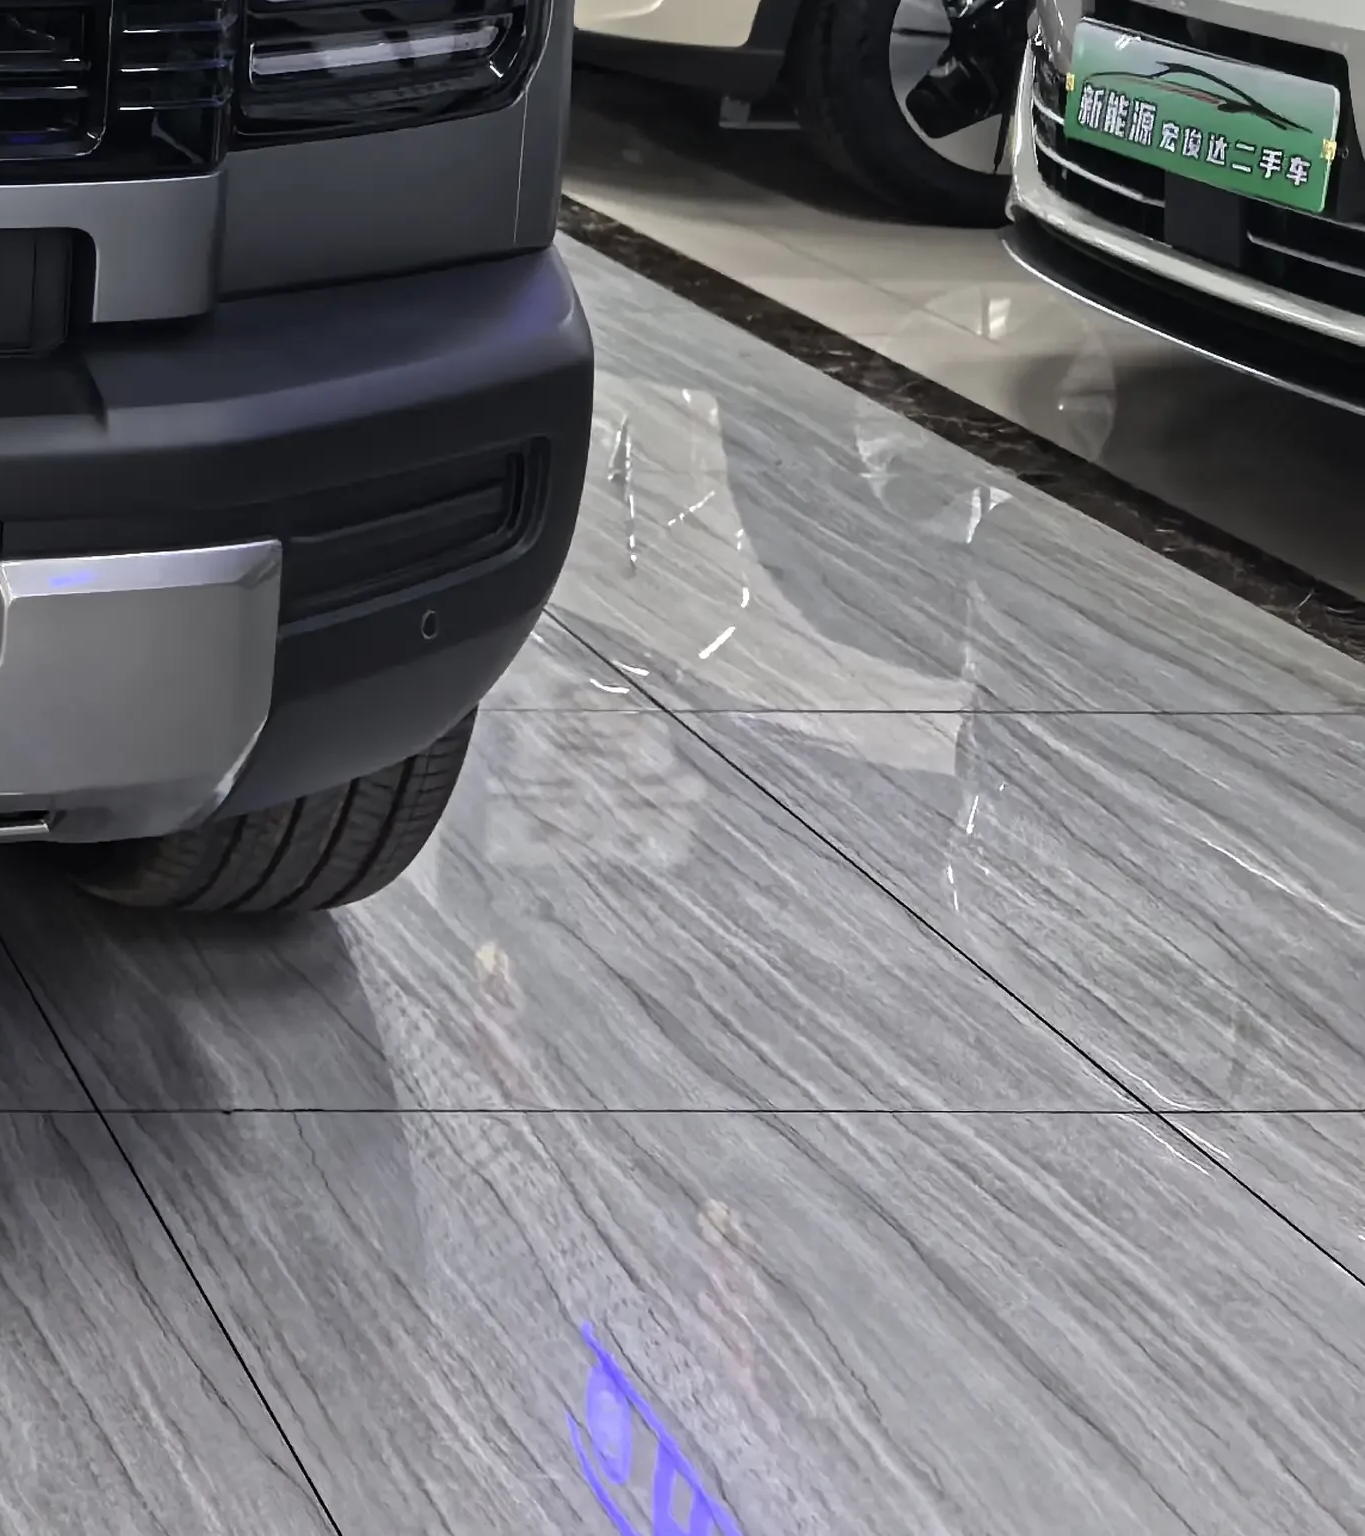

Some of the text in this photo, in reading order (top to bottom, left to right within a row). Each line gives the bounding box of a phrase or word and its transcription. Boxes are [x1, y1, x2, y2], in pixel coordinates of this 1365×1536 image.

[1077, 83, 1312, 188] 新能源 宏俊达二手车
